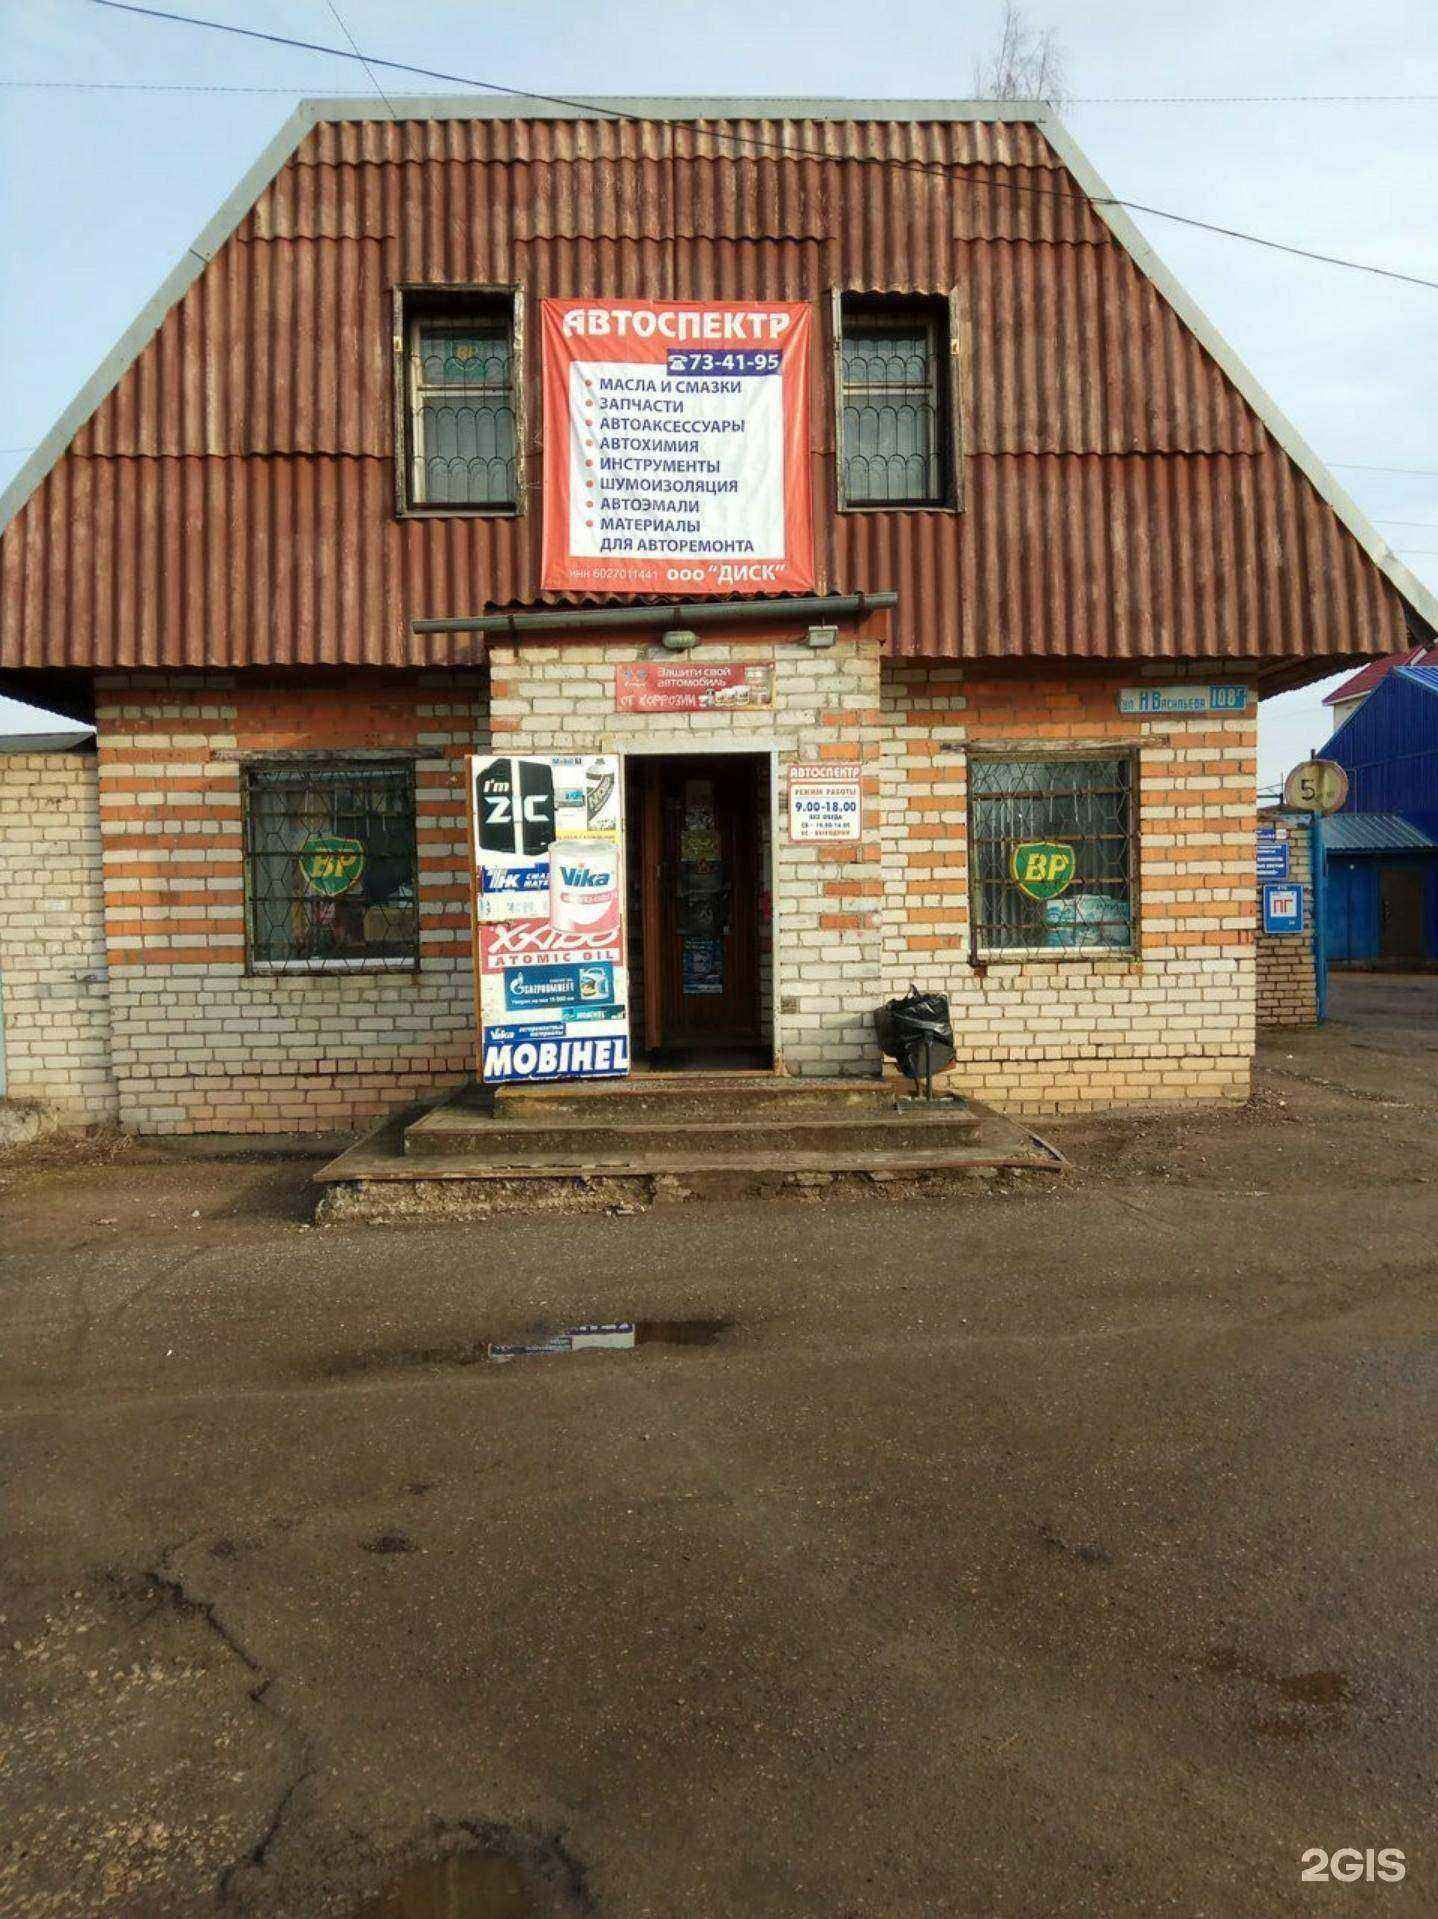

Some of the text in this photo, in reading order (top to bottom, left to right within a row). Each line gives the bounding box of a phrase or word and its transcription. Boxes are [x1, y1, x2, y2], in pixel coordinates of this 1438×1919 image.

[562, 308, 790, 340] АВТОСПЕКТР
[690, 354, 779, 371] 73-41-95
[600, 378, 742, 394] МАСЛА И СМАЗКИ
[600, 399, 684, 413] ЗАПЧАСТИ
[600, 418, 745, 433] АВТОАКСЕССУАРЫ
[600, 438, 699, 452] АВТОХИМИЯ
[600, 458, 720, 473] ИНСТРУМЕНТЫ
[600, 478, 738, 494] ШУМОИЗОЛЯЦИЯ
[601, 498, 699, 512] АВТОЭМАЛИ
[601, 518, 700, 532] МАТЕРИАЛЫ
[600, 538, 754, 553] ДЛЯ АВТОРЕМОНТА
[657, 677, 726, 687] автомобиль
[790, 767, 859, 778] АВТОСПЕКТР
[1301, 779, 1315, 800] 5
[795, 801, 857, 812] 9.00-18.00
[1025, 853, 1069, 880] BP
[560, 863, 612, 888] Vika
[495, 950, 614, 966] ATOMIC OIL
[485, 1039, 629, 1077] MOBIHEL
